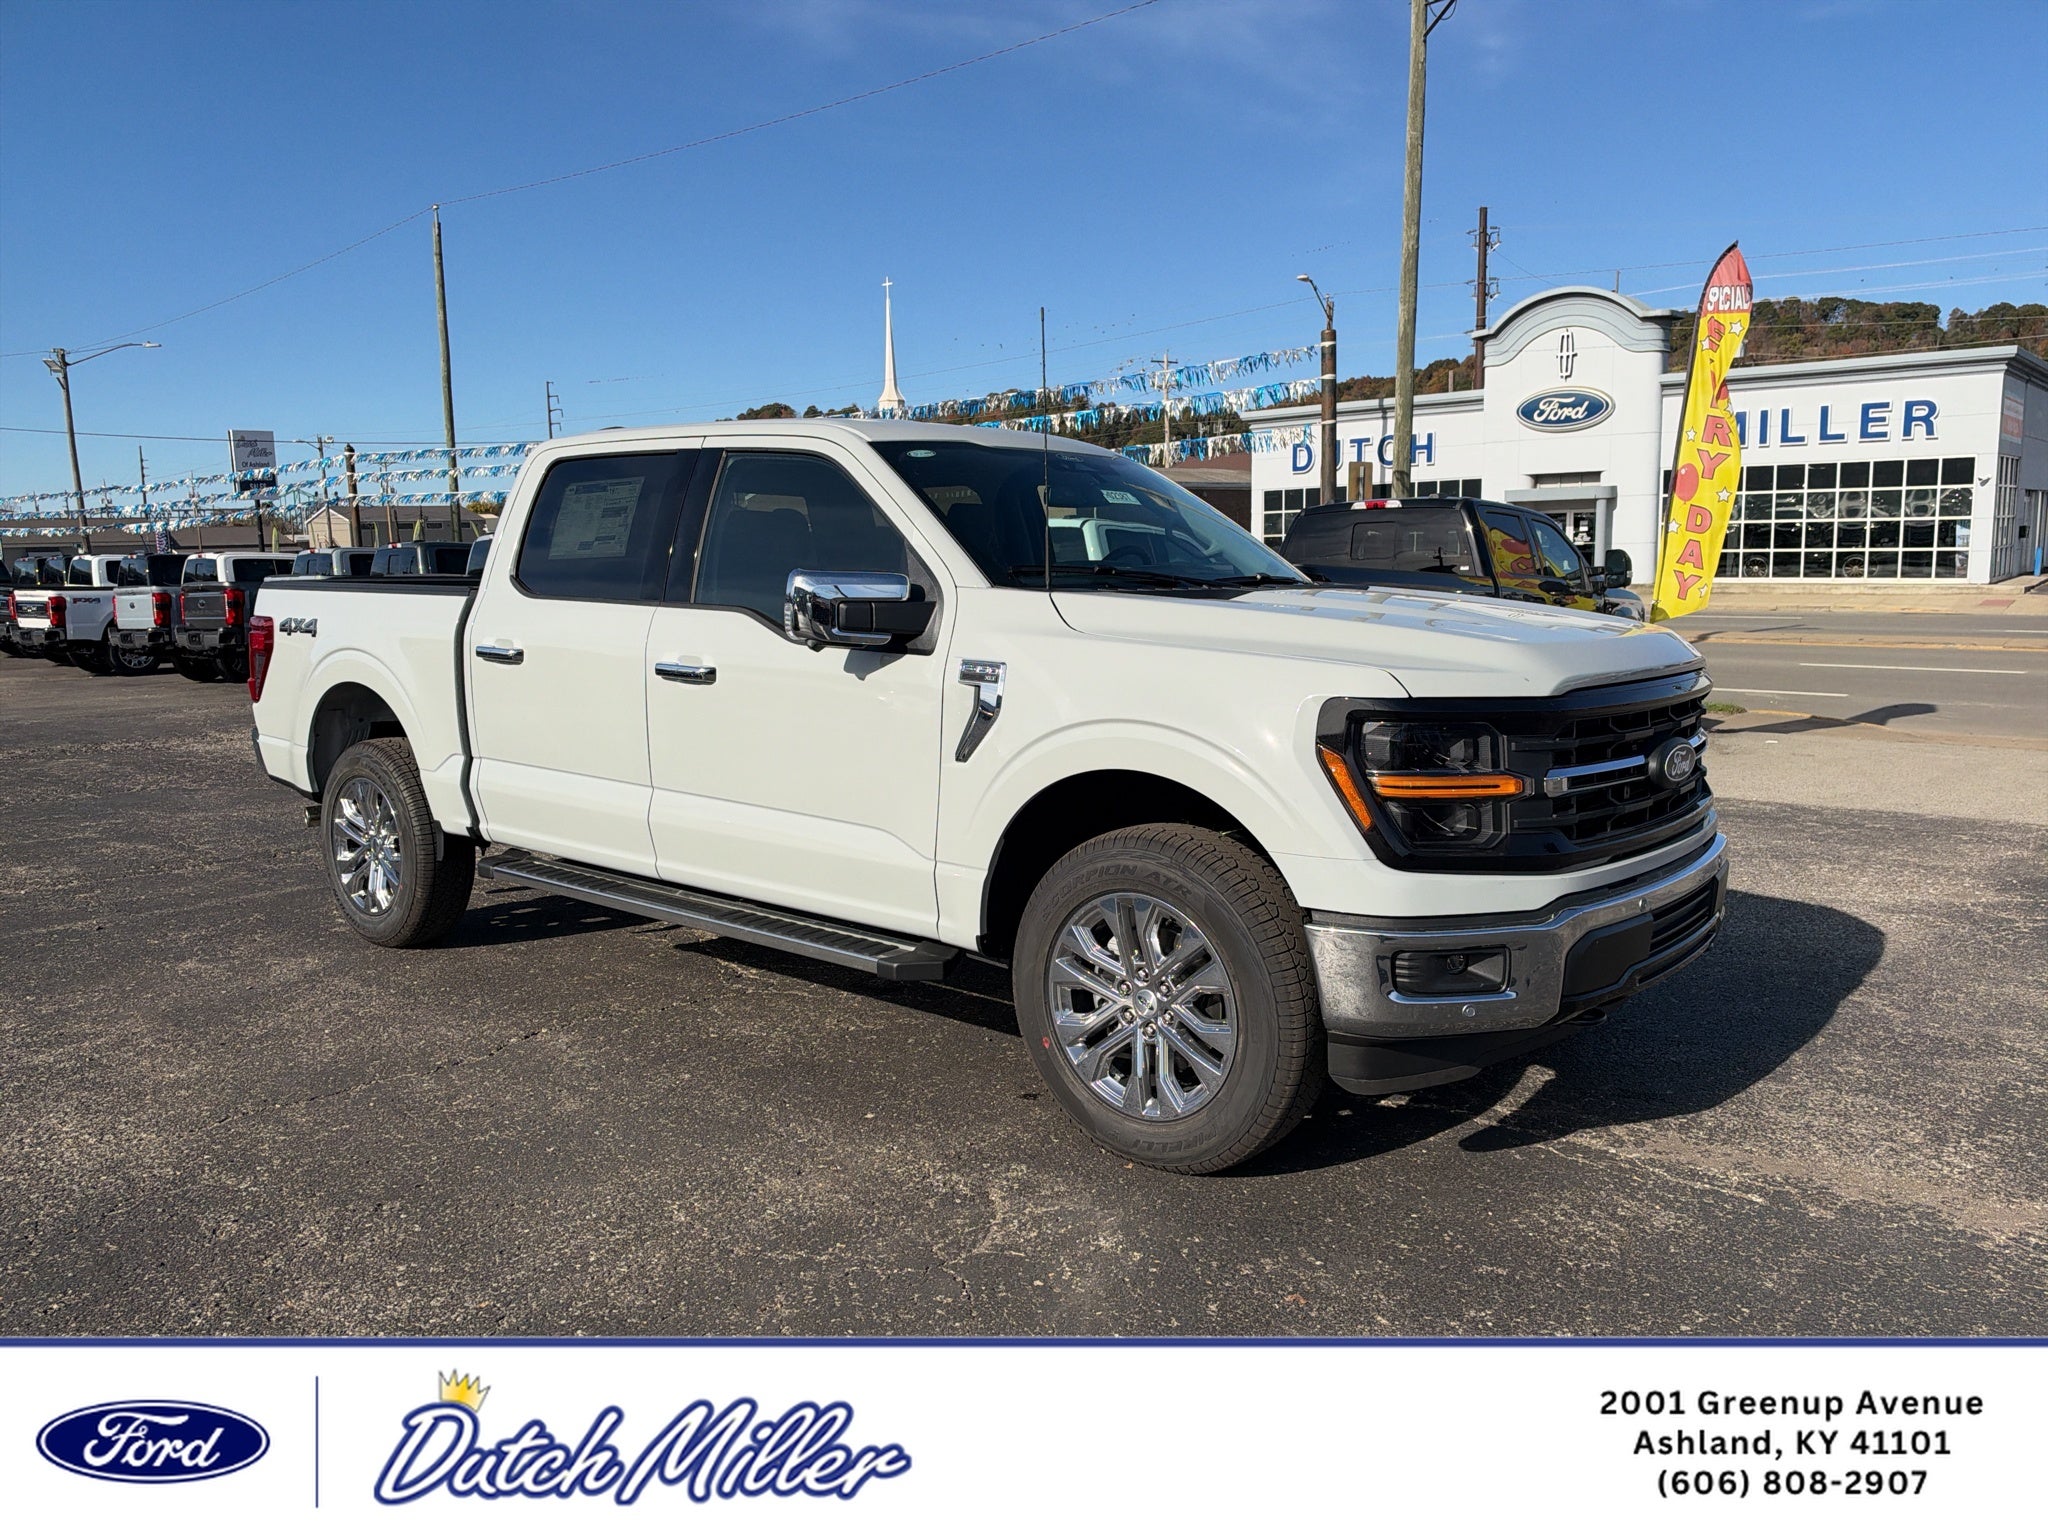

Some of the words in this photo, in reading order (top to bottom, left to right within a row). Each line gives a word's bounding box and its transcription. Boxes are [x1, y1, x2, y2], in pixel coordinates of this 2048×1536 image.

[1533, 396, 1589, 423] Ford
[1697, 316, 1733, 480] ERY
[1292, 432, 1436, 474] DTCH
[1673, 504, 1712, 601] DAY
[1671, 750, 1691, 776] Ford
[1144, 871, 1193, 899] ATR
